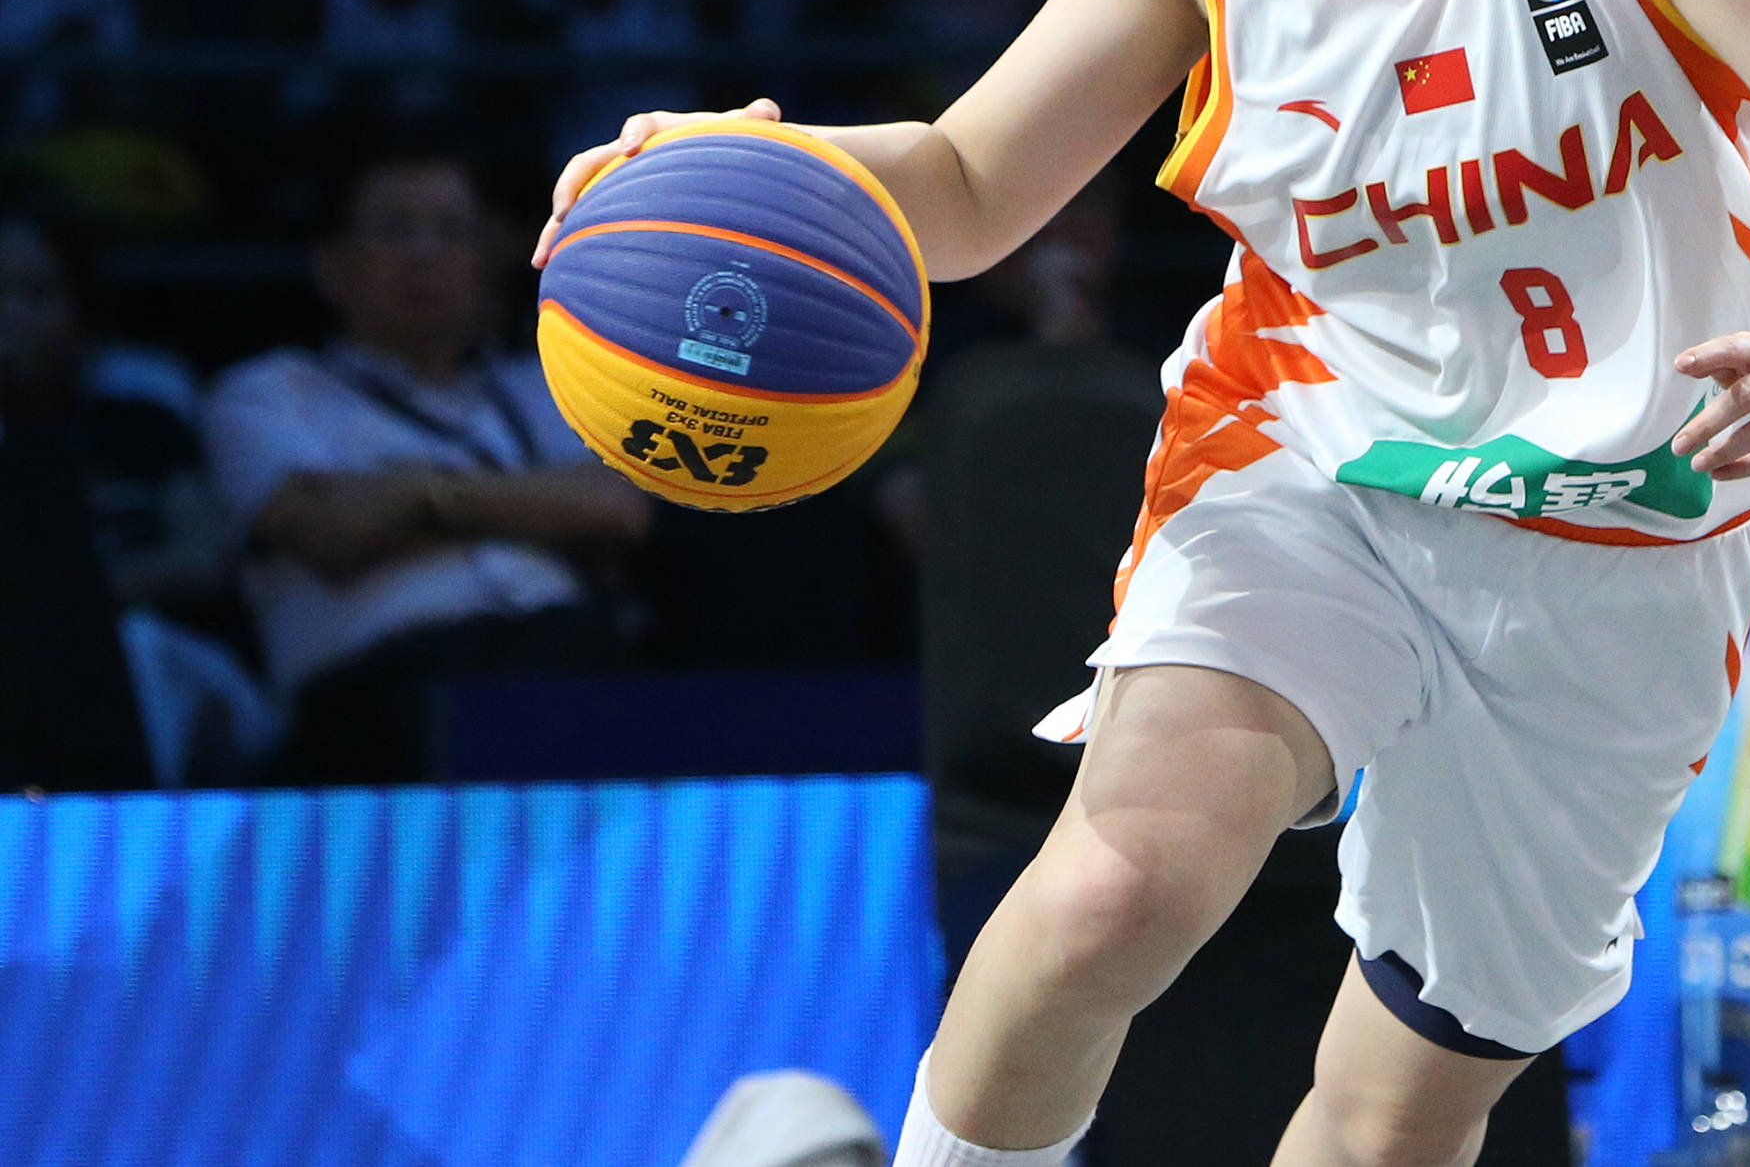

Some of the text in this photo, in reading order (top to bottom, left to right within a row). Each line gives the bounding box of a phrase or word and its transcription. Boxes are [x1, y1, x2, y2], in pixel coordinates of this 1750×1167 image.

[1544, 12, 1587, 42] FIBA
[1292, 91, 1683, 269] CHINA
[1500, 267, 1588, 378] 8
[651, 388, 769, 426] OFFICIAL BALL
[666, 411, 744, 439] FIBA 3x3
